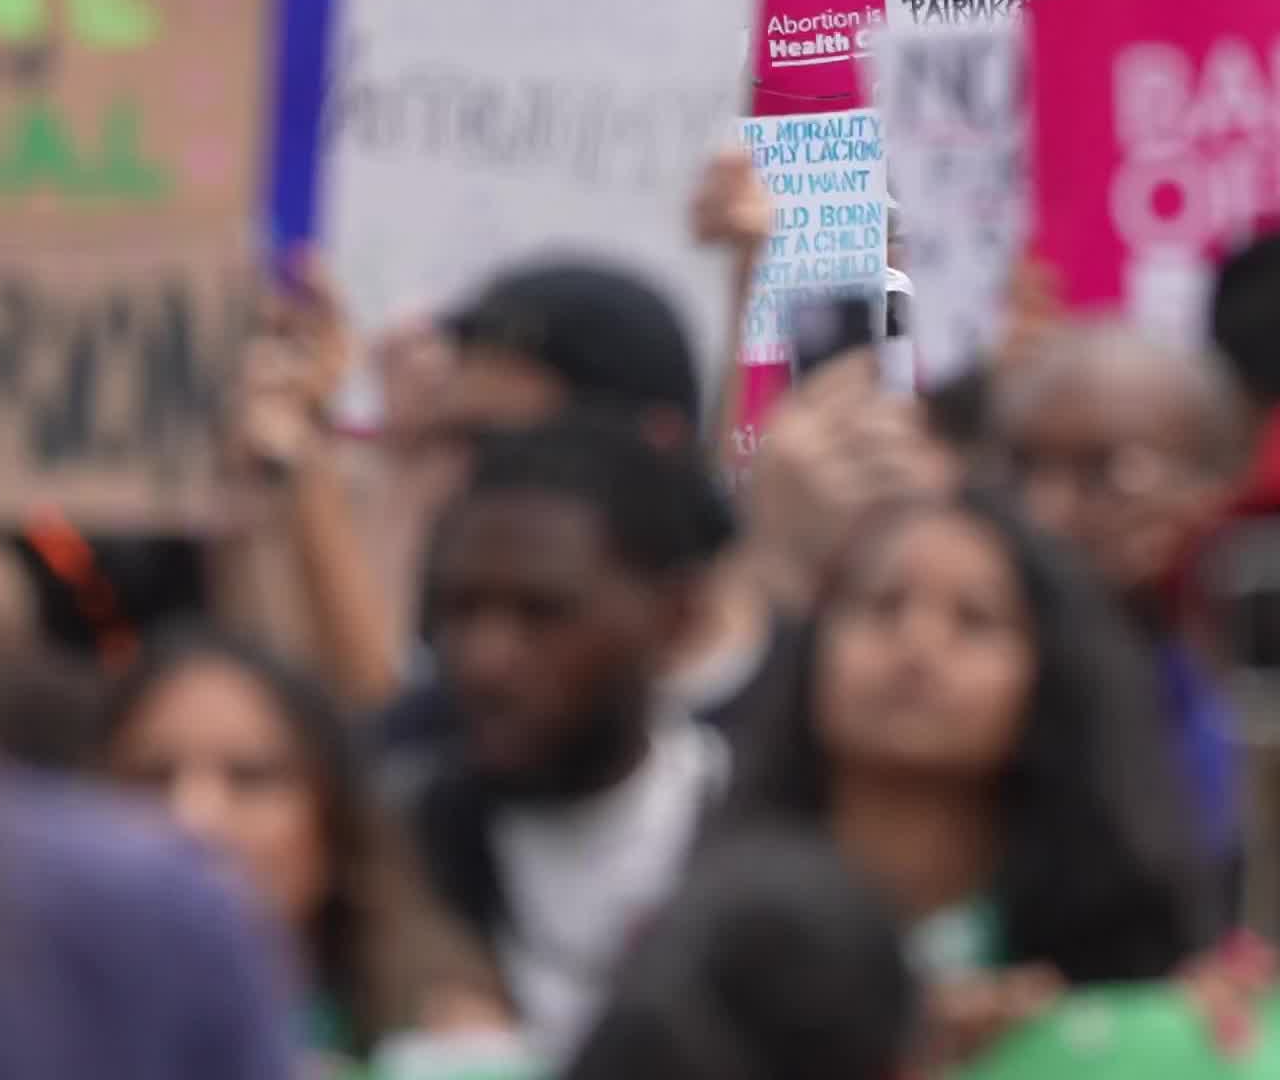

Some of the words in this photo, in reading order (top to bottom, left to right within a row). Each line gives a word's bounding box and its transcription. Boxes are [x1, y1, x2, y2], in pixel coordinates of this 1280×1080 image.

[767, 8, 860, 36] Abortion
[865, 5, 882, 22] is
[768, 31, 849, 59] Health
[776, 115, 881, 141] MORALITY
[805, 138, 883, 164] LACKING
[819, 202, 882, 227] BORN
